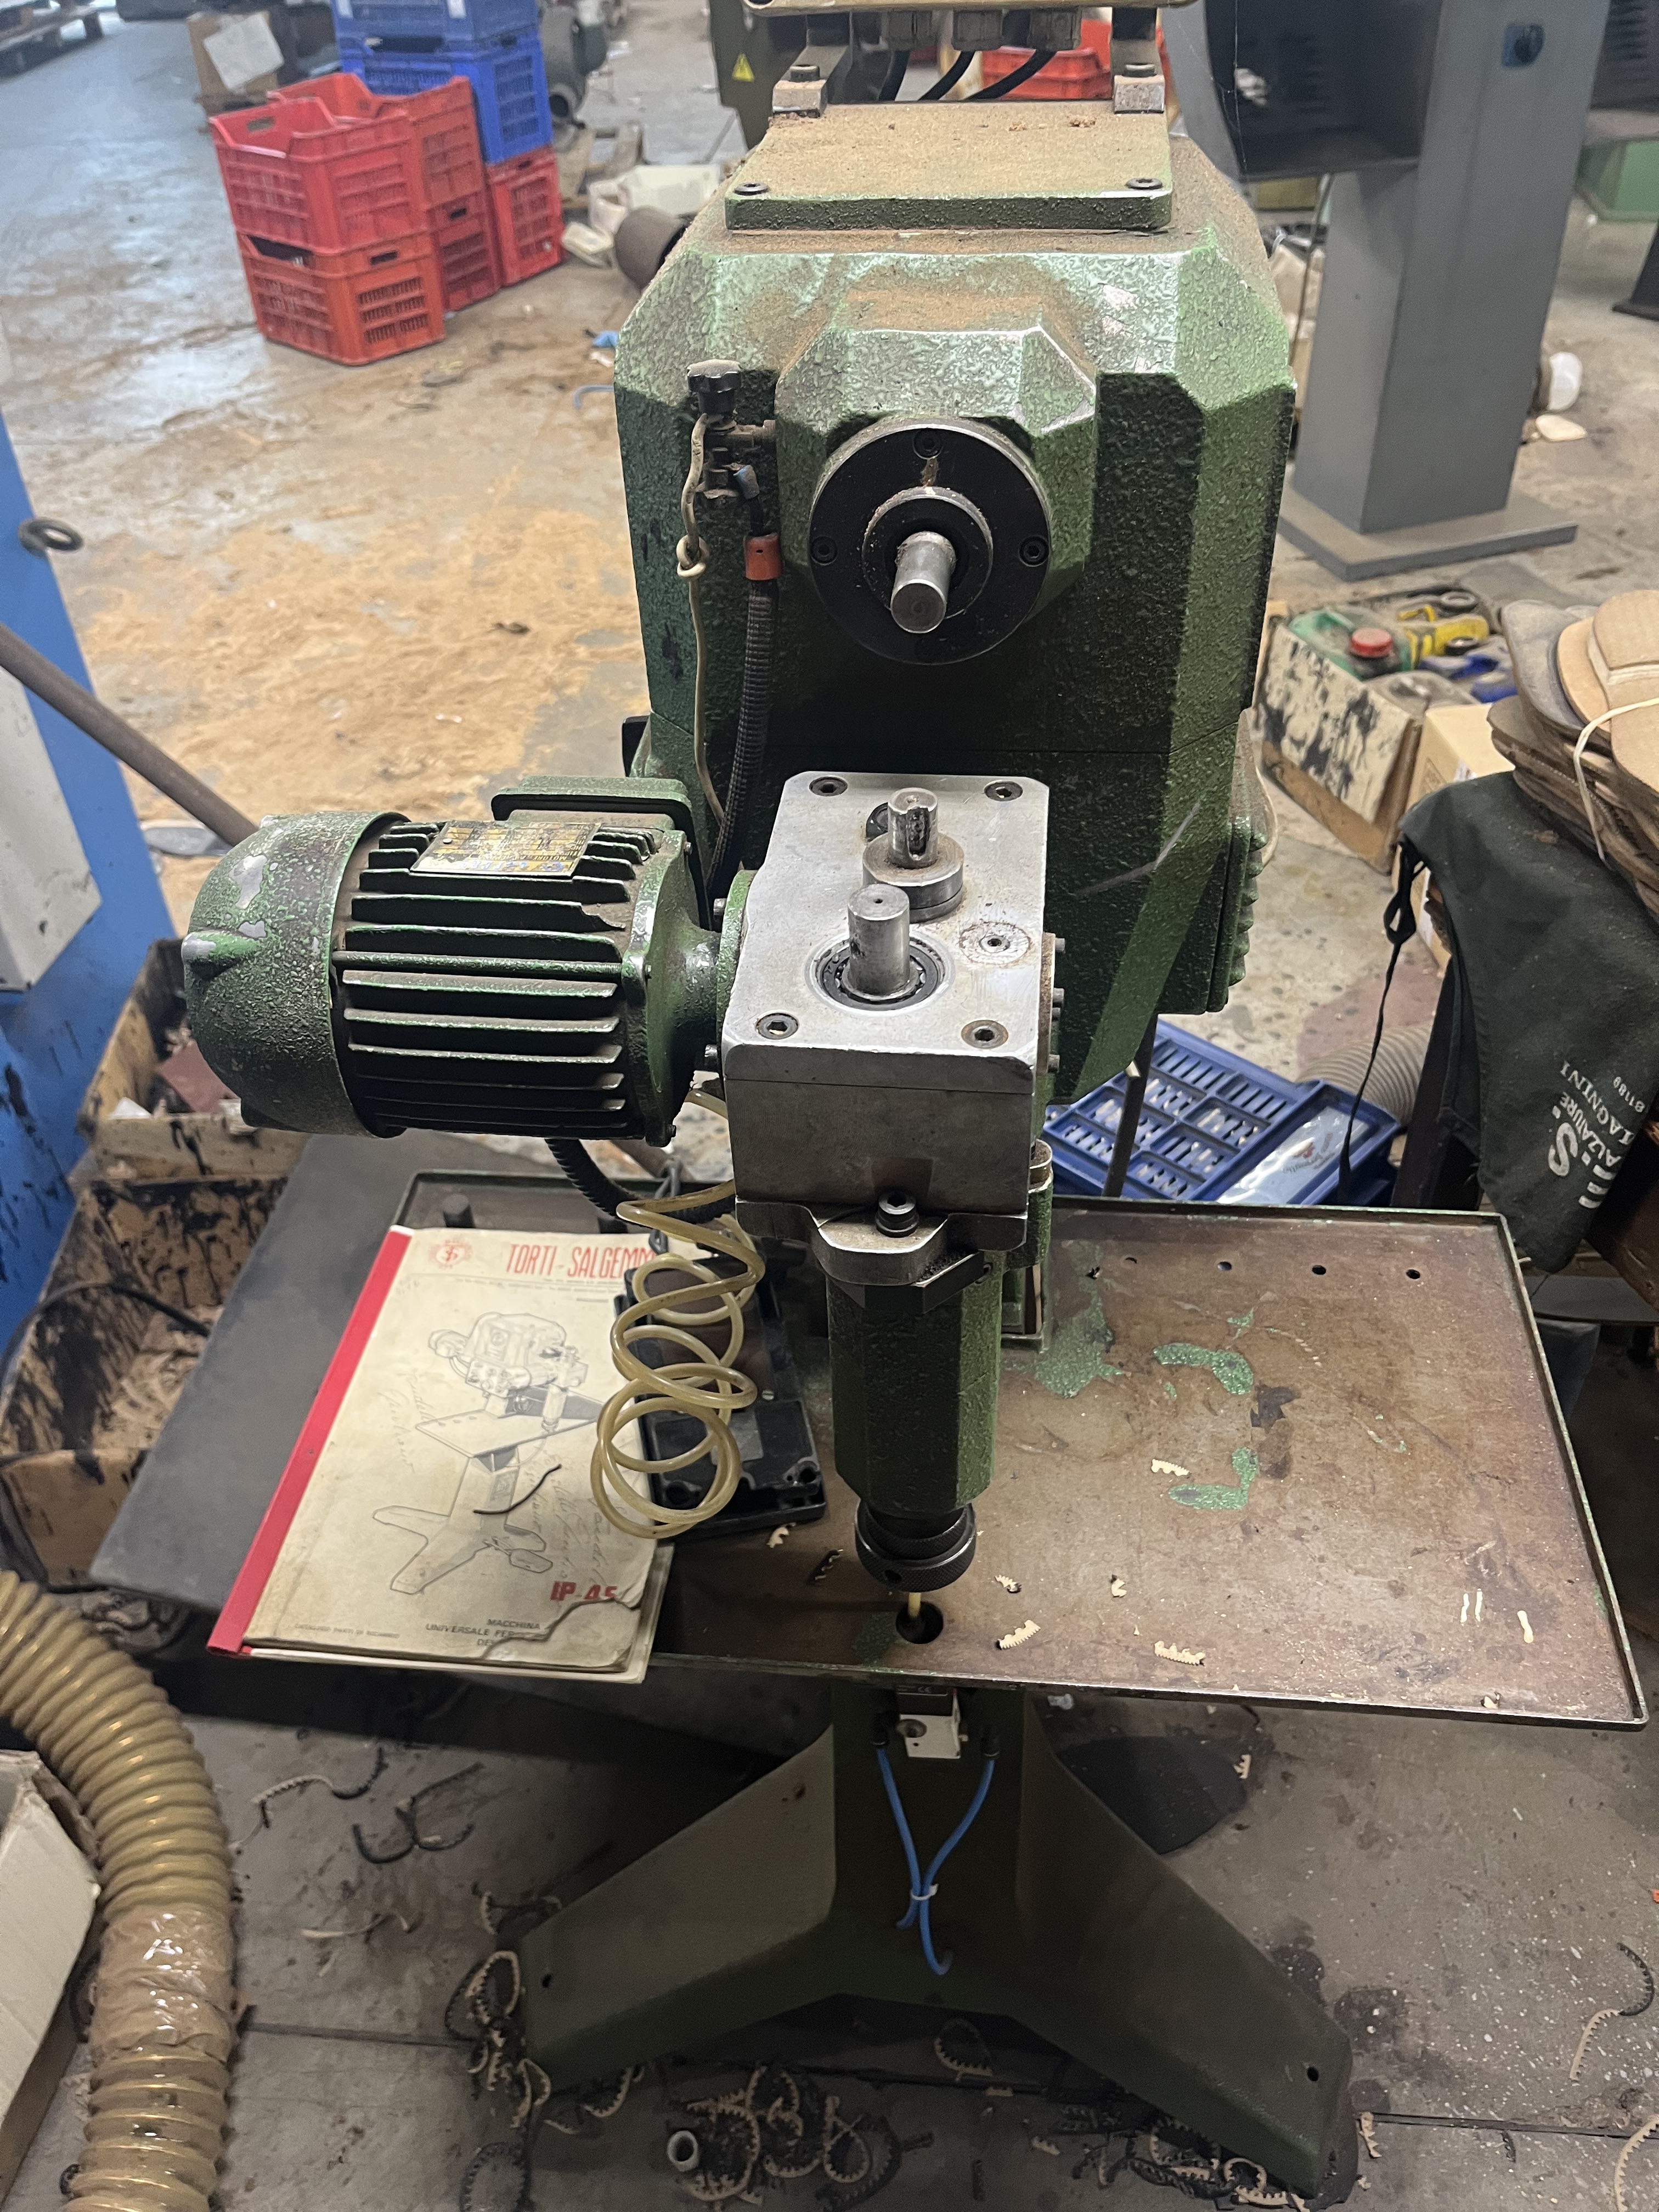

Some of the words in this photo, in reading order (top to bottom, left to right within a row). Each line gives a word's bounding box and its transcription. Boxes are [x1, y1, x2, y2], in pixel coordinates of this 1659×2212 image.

[506, 1244, 557, 1276] TORTI
[425, 1623, 490, 1636] UNIVERSALE
[487, 1619, 540, 1630] MACCHINA
